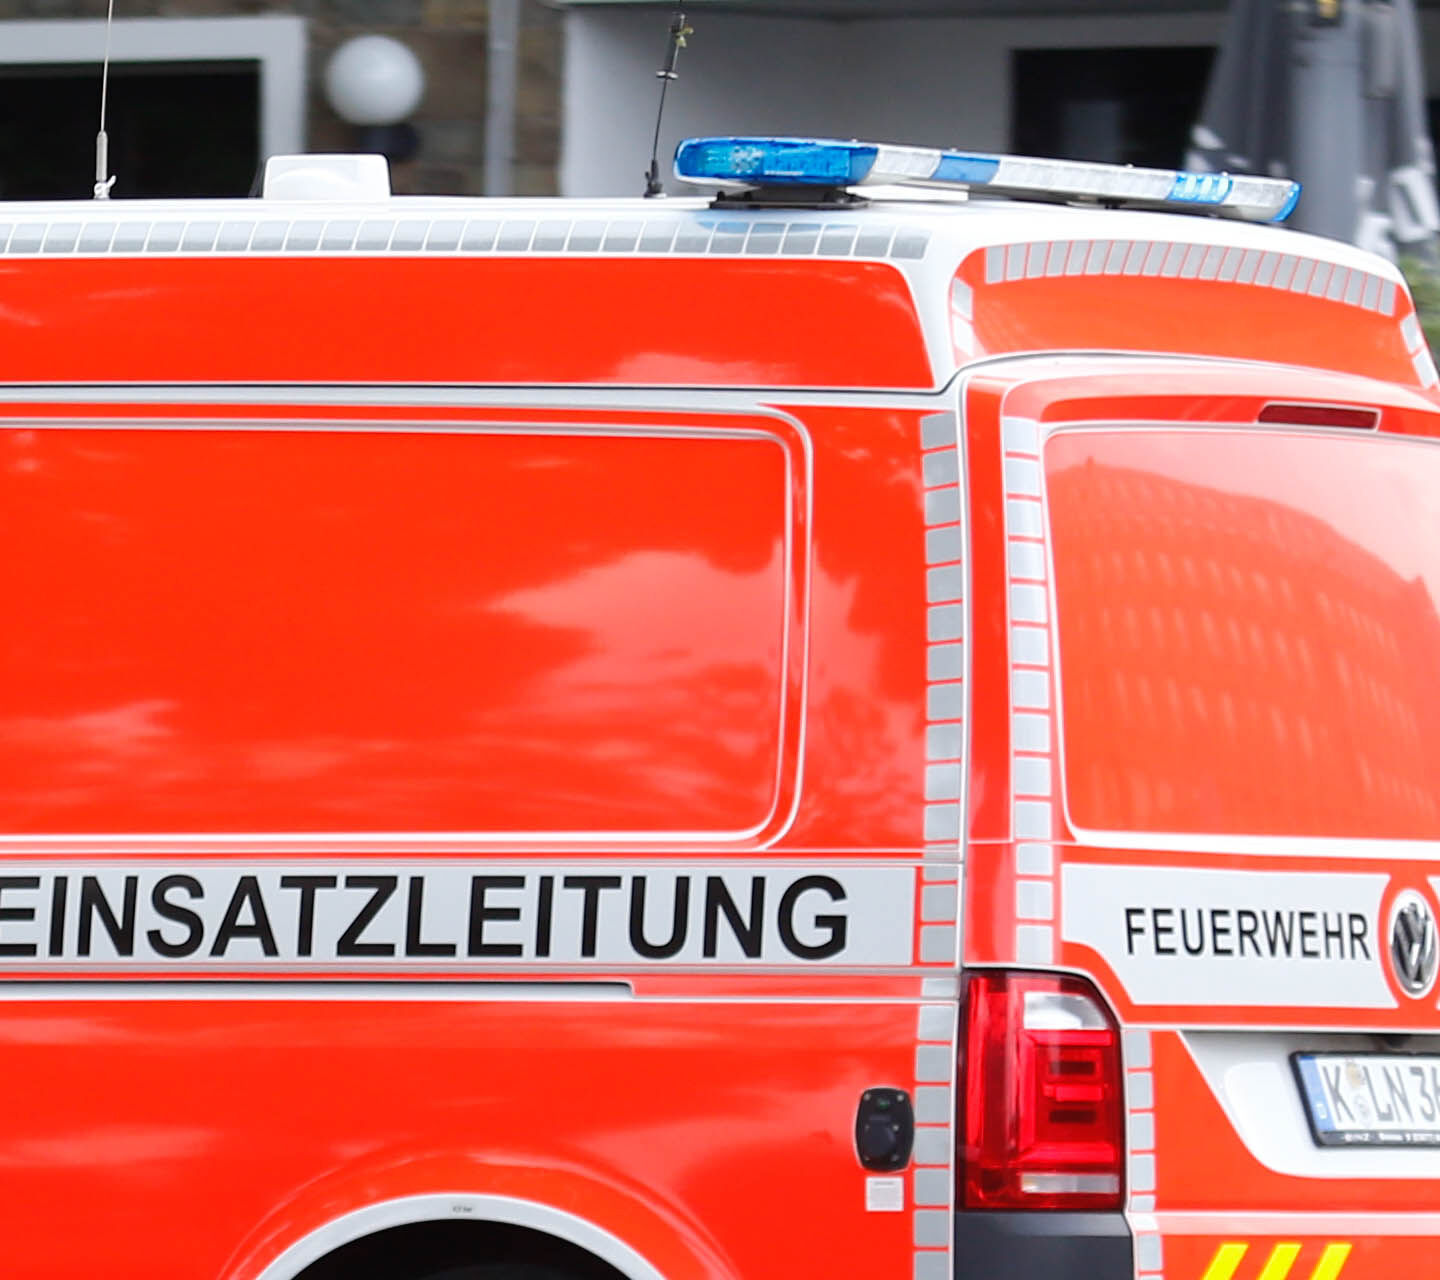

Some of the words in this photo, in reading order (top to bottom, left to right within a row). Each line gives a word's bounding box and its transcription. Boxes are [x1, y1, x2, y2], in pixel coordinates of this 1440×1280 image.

[1124, 907, 1373, 960] FEUERWEHR
[1322, 1066, 1356, 1123] K
[1363, 1066, 1414, 1122] LN
